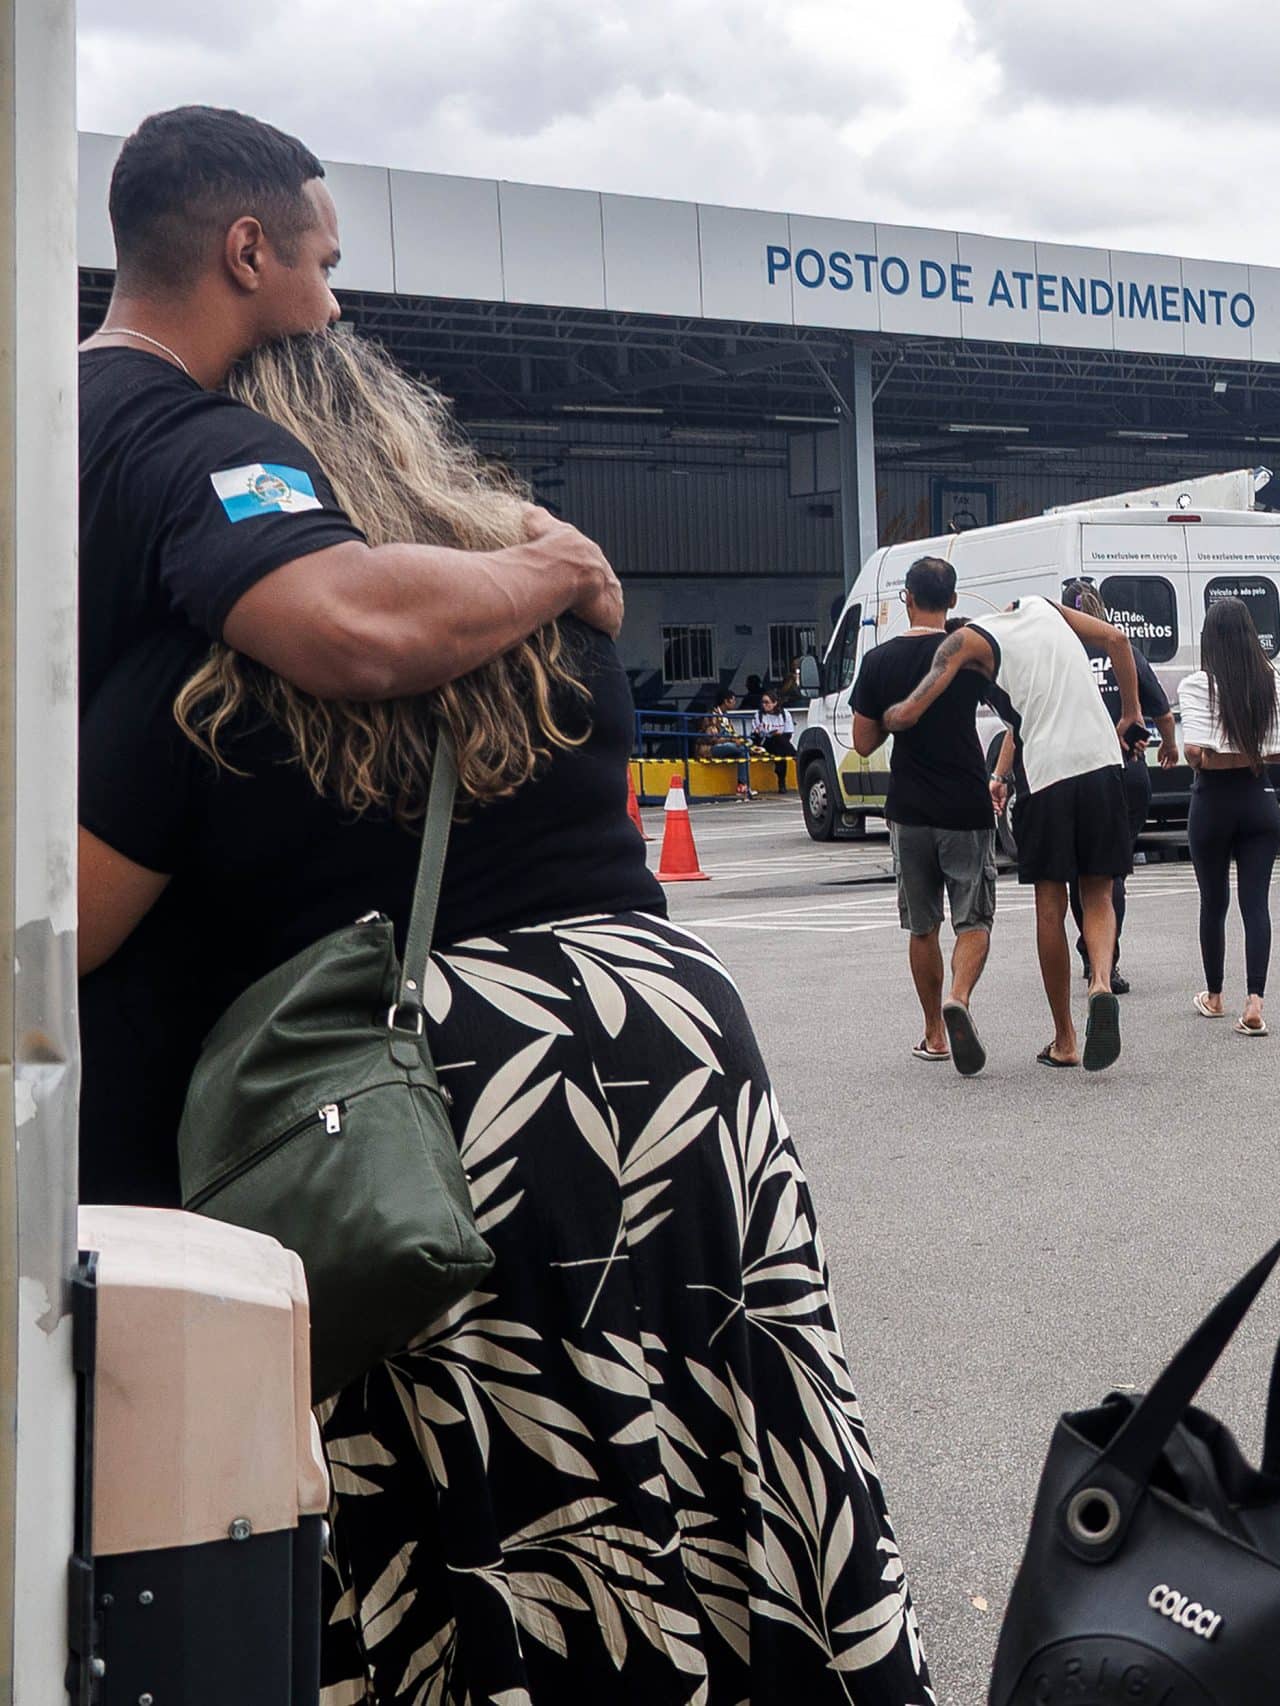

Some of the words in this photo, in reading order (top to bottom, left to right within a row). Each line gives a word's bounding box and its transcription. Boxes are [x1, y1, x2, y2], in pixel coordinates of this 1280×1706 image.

[766, 245, 909, 295] POSTO
[921, 260, 974, 303] DE
[988, 269, 1255, 328] ATENDIMENTO
[1104, 608, 1130, 622] Van
[1148, 1584, 1222, 1639] COLCCI
